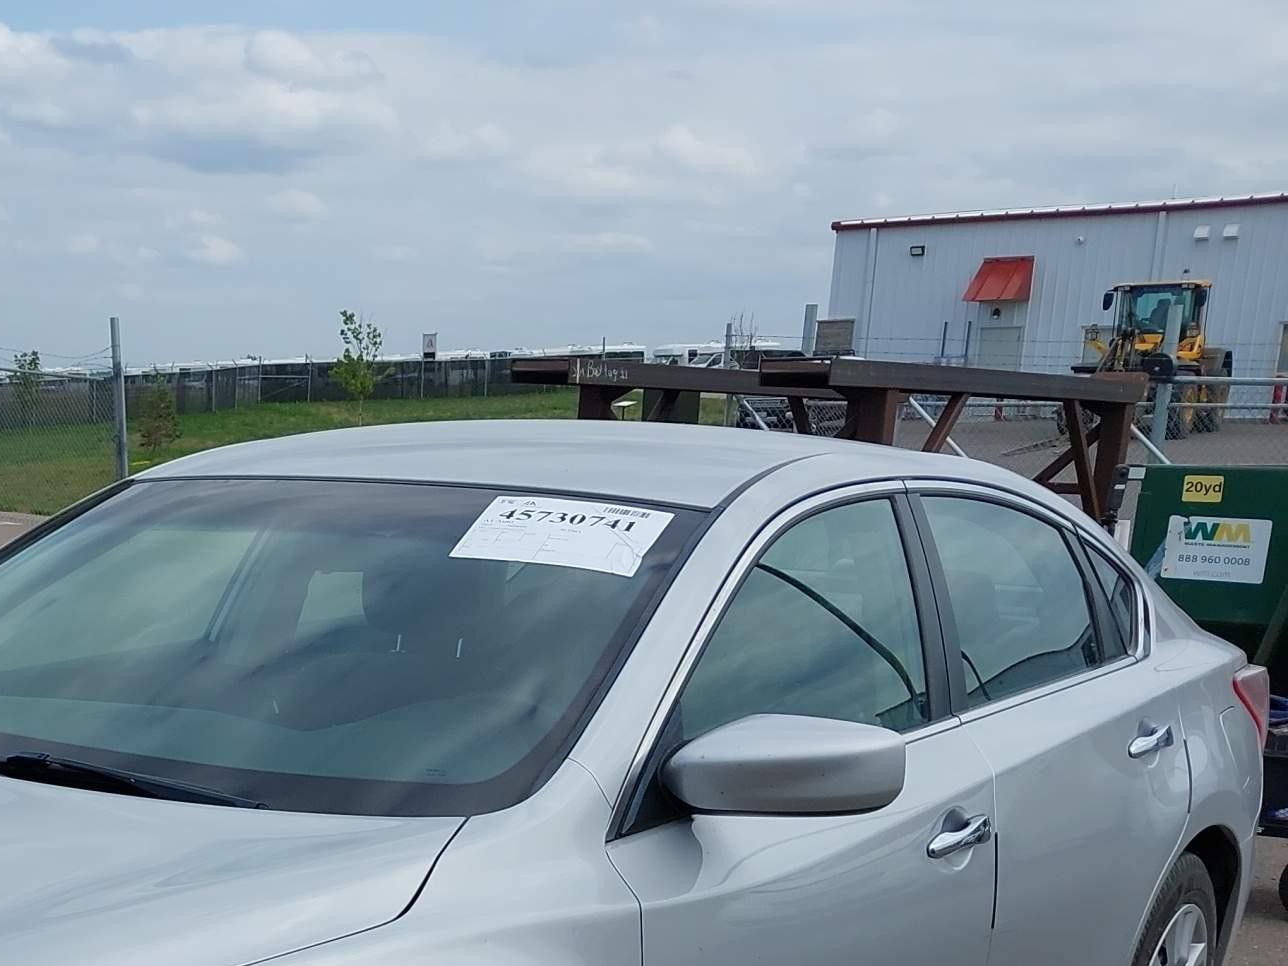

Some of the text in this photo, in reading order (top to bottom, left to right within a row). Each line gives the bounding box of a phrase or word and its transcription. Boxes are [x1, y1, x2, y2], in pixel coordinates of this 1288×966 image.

[1185, 480, 1222, 496] 20yd
[499, 508, 636, 533] 45730741
[1184, 521, 1250, 543] WM
[1178, 554, 1250, 566] 888 960 0008
